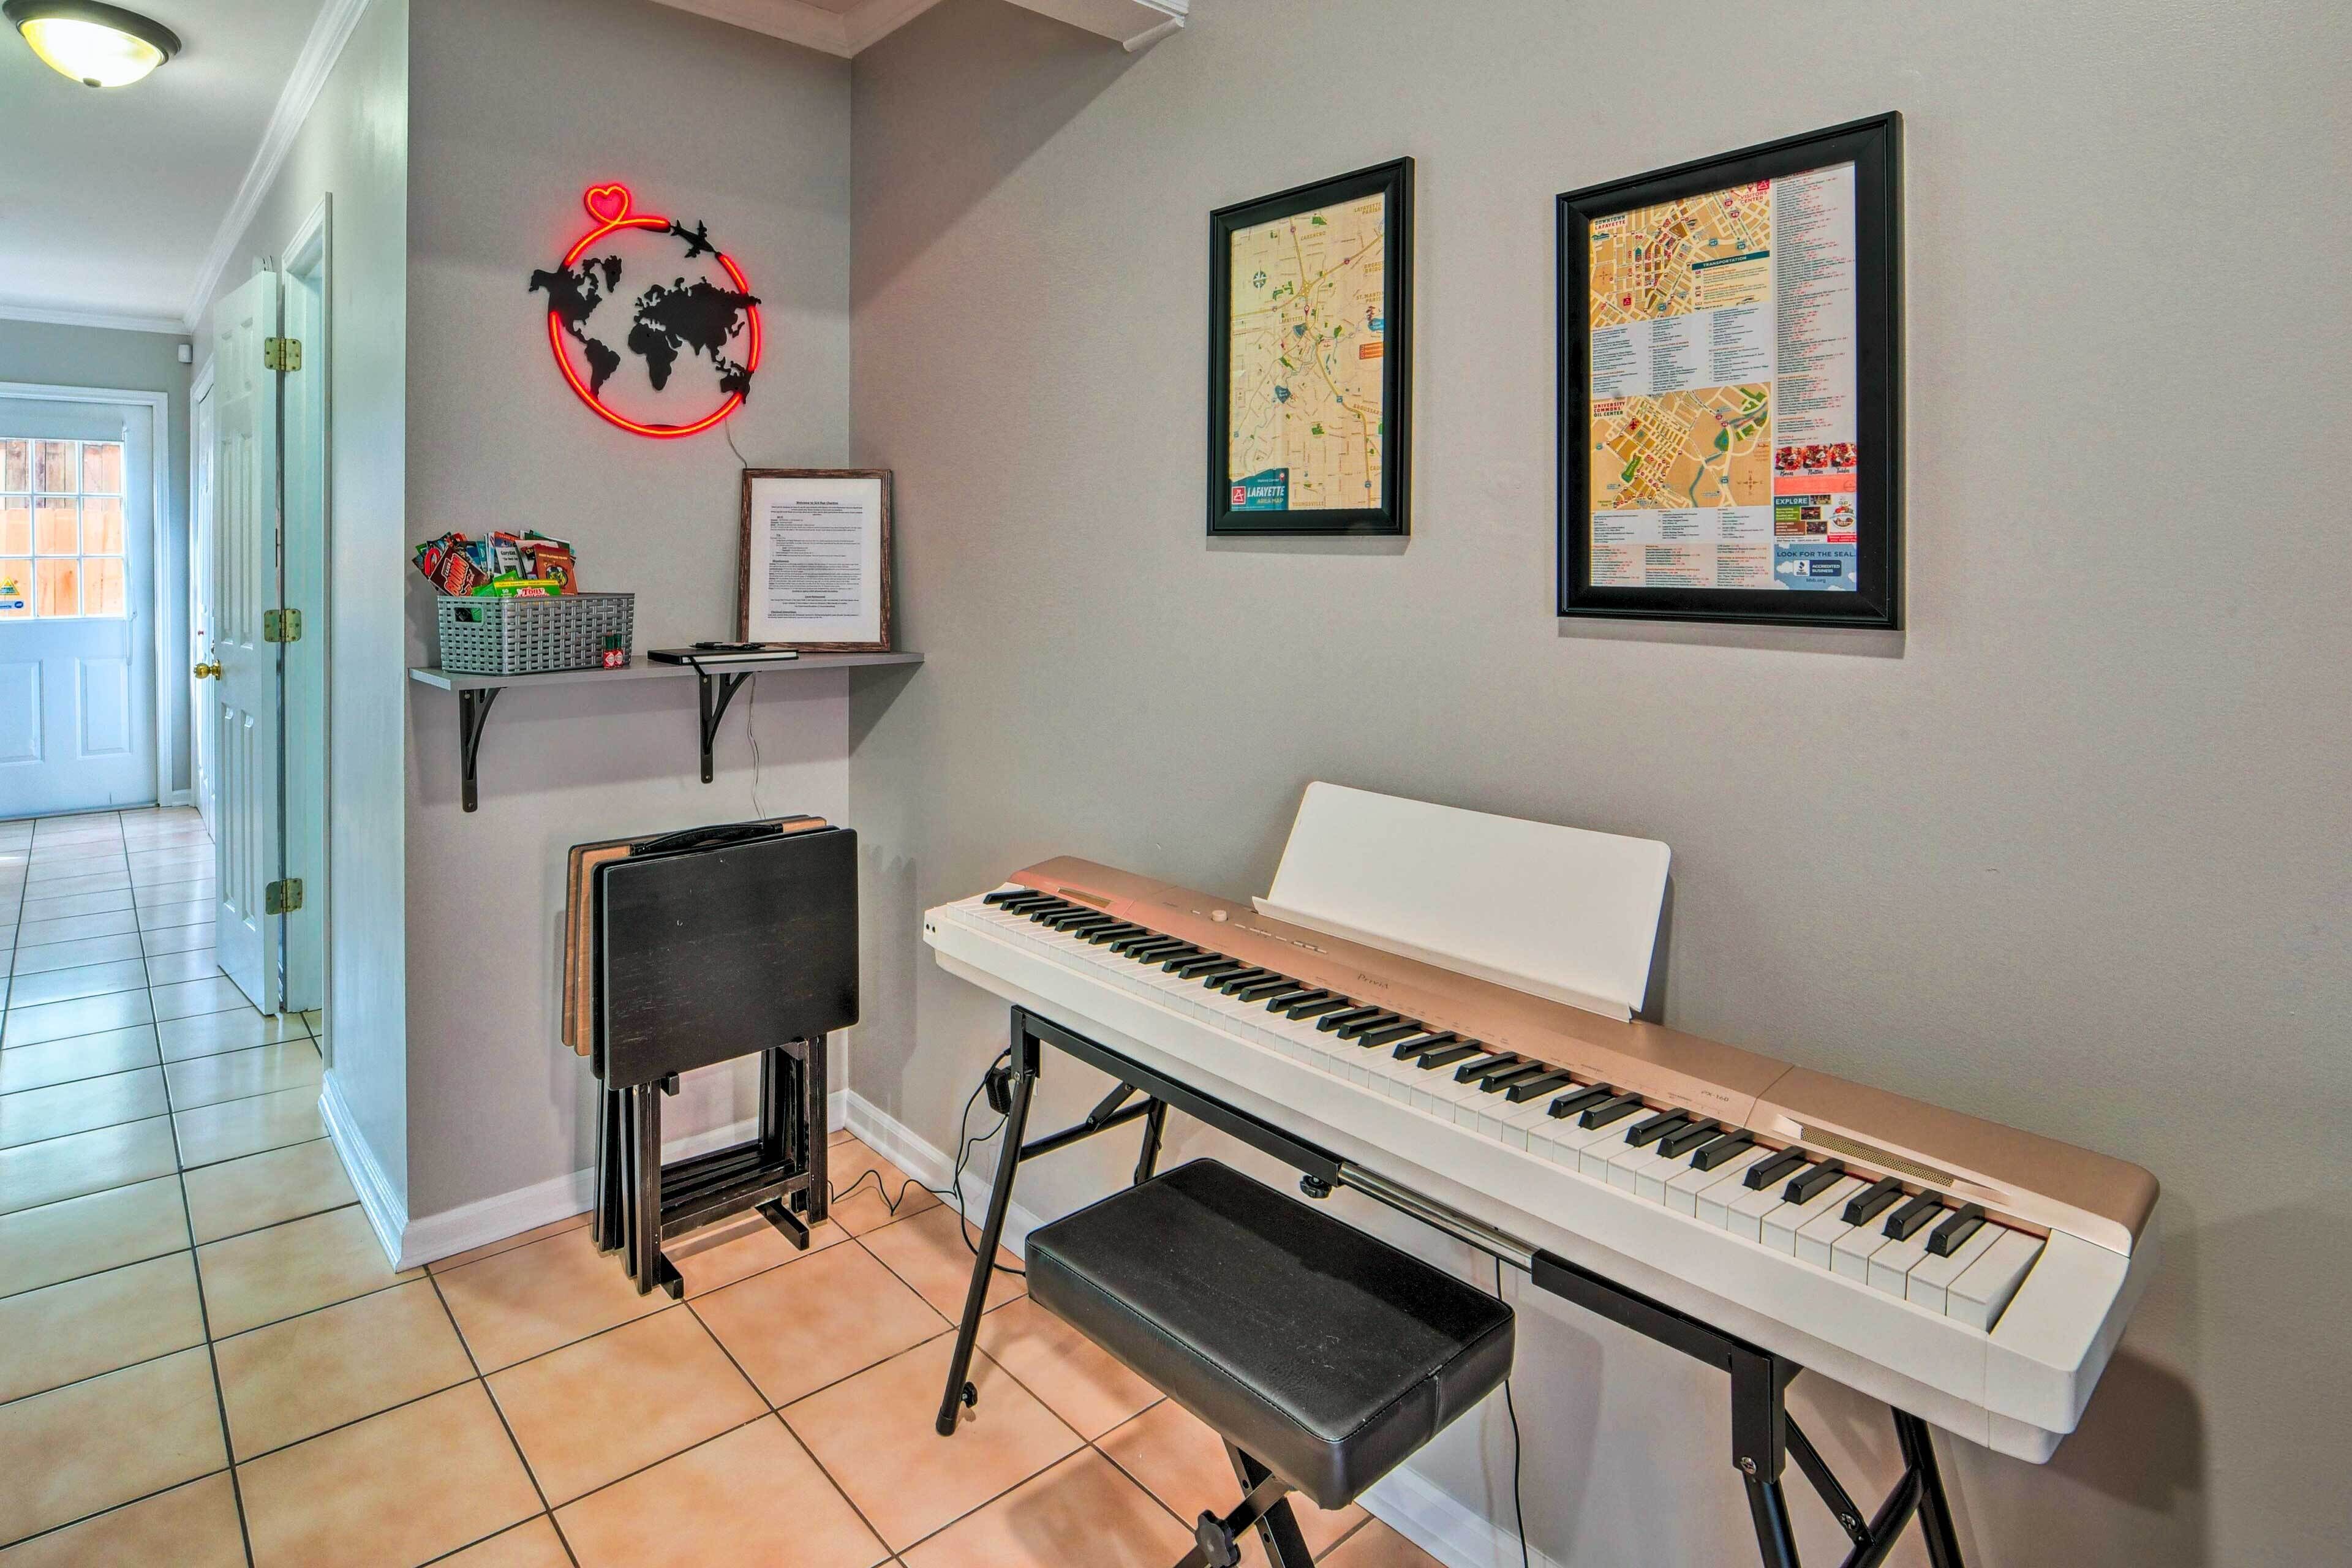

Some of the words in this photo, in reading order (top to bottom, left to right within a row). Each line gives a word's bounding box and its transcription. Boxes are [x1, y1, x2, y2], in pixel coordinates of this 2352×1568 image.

[1740, 190, 1768, 200] VISITORS
[1594, 215, 1626, 225] DOWNTOWN
[1595, 220, 1626, 230] LAFAYETTE
[1703, 256, 1747, 267] TRANSPORTATION
[1247, 486, 1285, 497] LAFAYETTE
[445, 554, 468, 597] BOUDIN
[1701, 1090, 1730, 1102] PX-160
